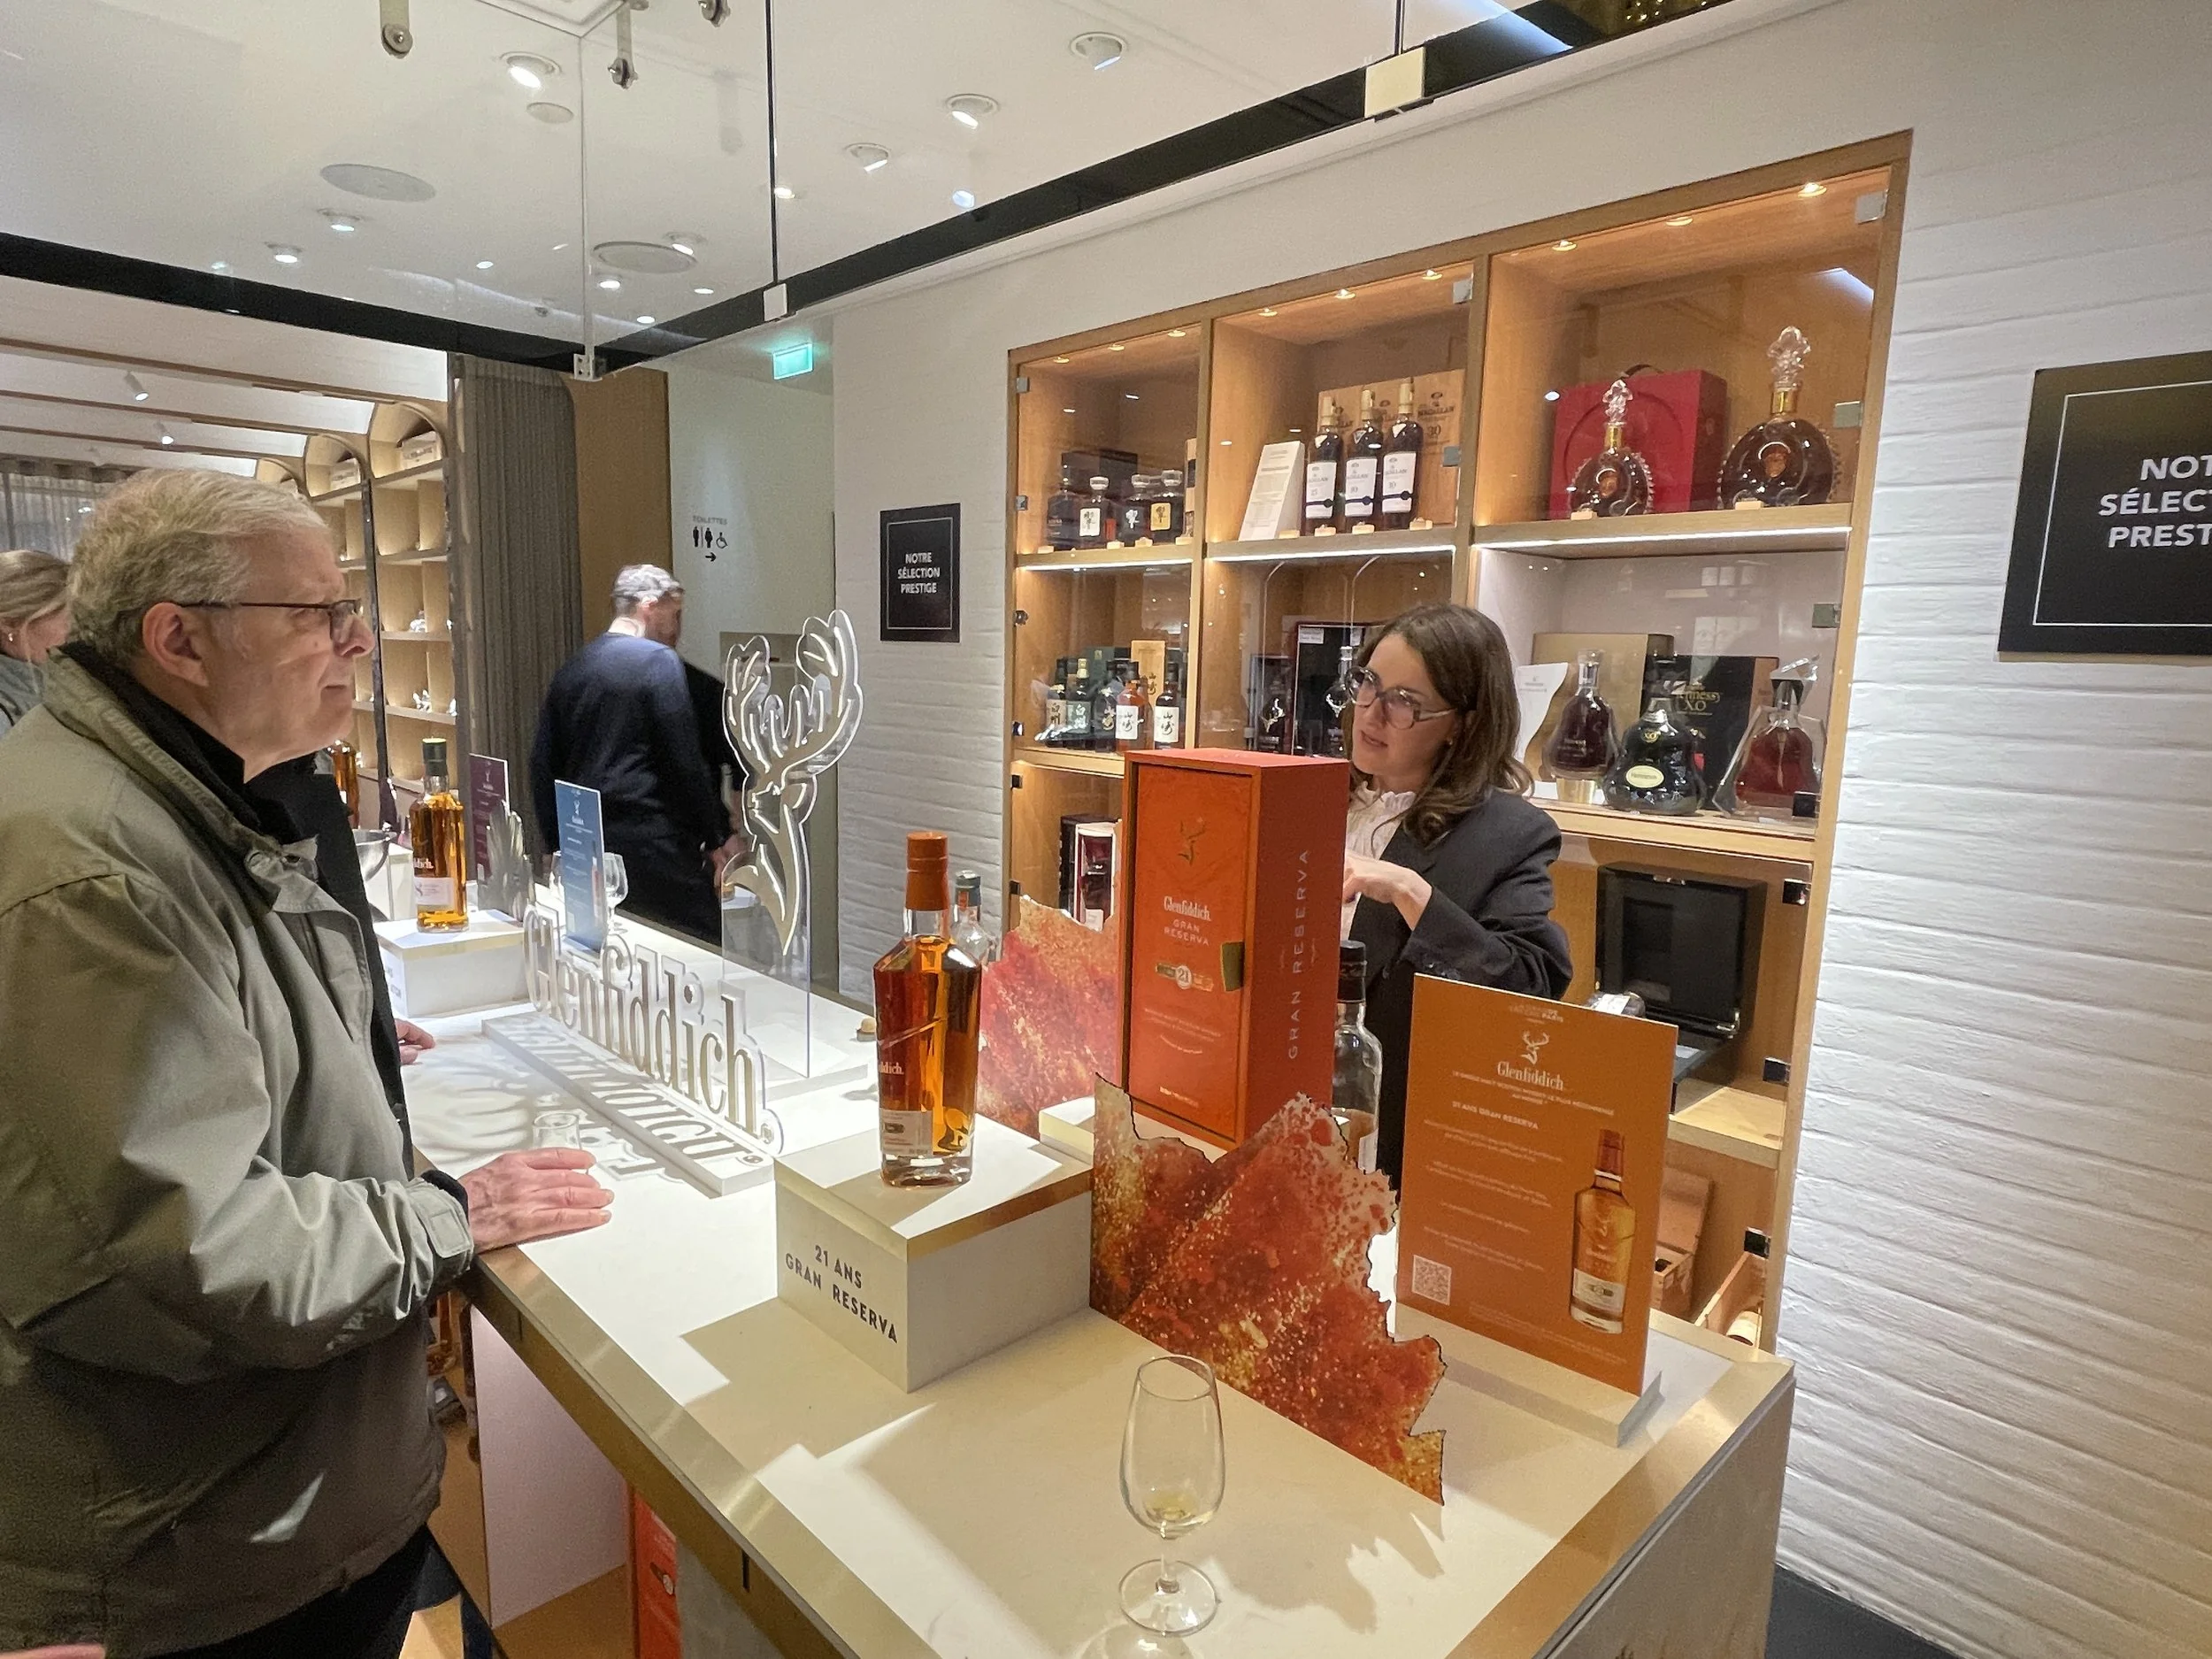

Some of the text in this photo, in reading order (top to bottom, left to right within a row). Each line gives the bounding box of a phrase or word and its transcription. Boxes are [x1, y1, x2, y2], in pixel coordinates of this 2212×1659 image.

[2098, 488, 2212, 517] SÉLEC
[905, 552, 933, 565] NOTRE
[897, 566, 941, 580] SÉLECTION
[900, 582, 938, 594] PRESTIGE
[1164, 895, 1211, 922] Glenfiddich
[1172, 918, 1201, 933] GRAN
[1164, 926, 1210, 947] RESERVA
[1287, 849, 1310, 1060] GRAN RESERVA
[1178, 967, 1189, 984] 21
[1497, 1060, 1563, 1092] Glenfiddich
[1502, 1114, 1539, 1130] RESERVA
[815, 1244, 862, 1289] 21 ANS
[785, 1253, 898, 1344] GRAN RESERVA
